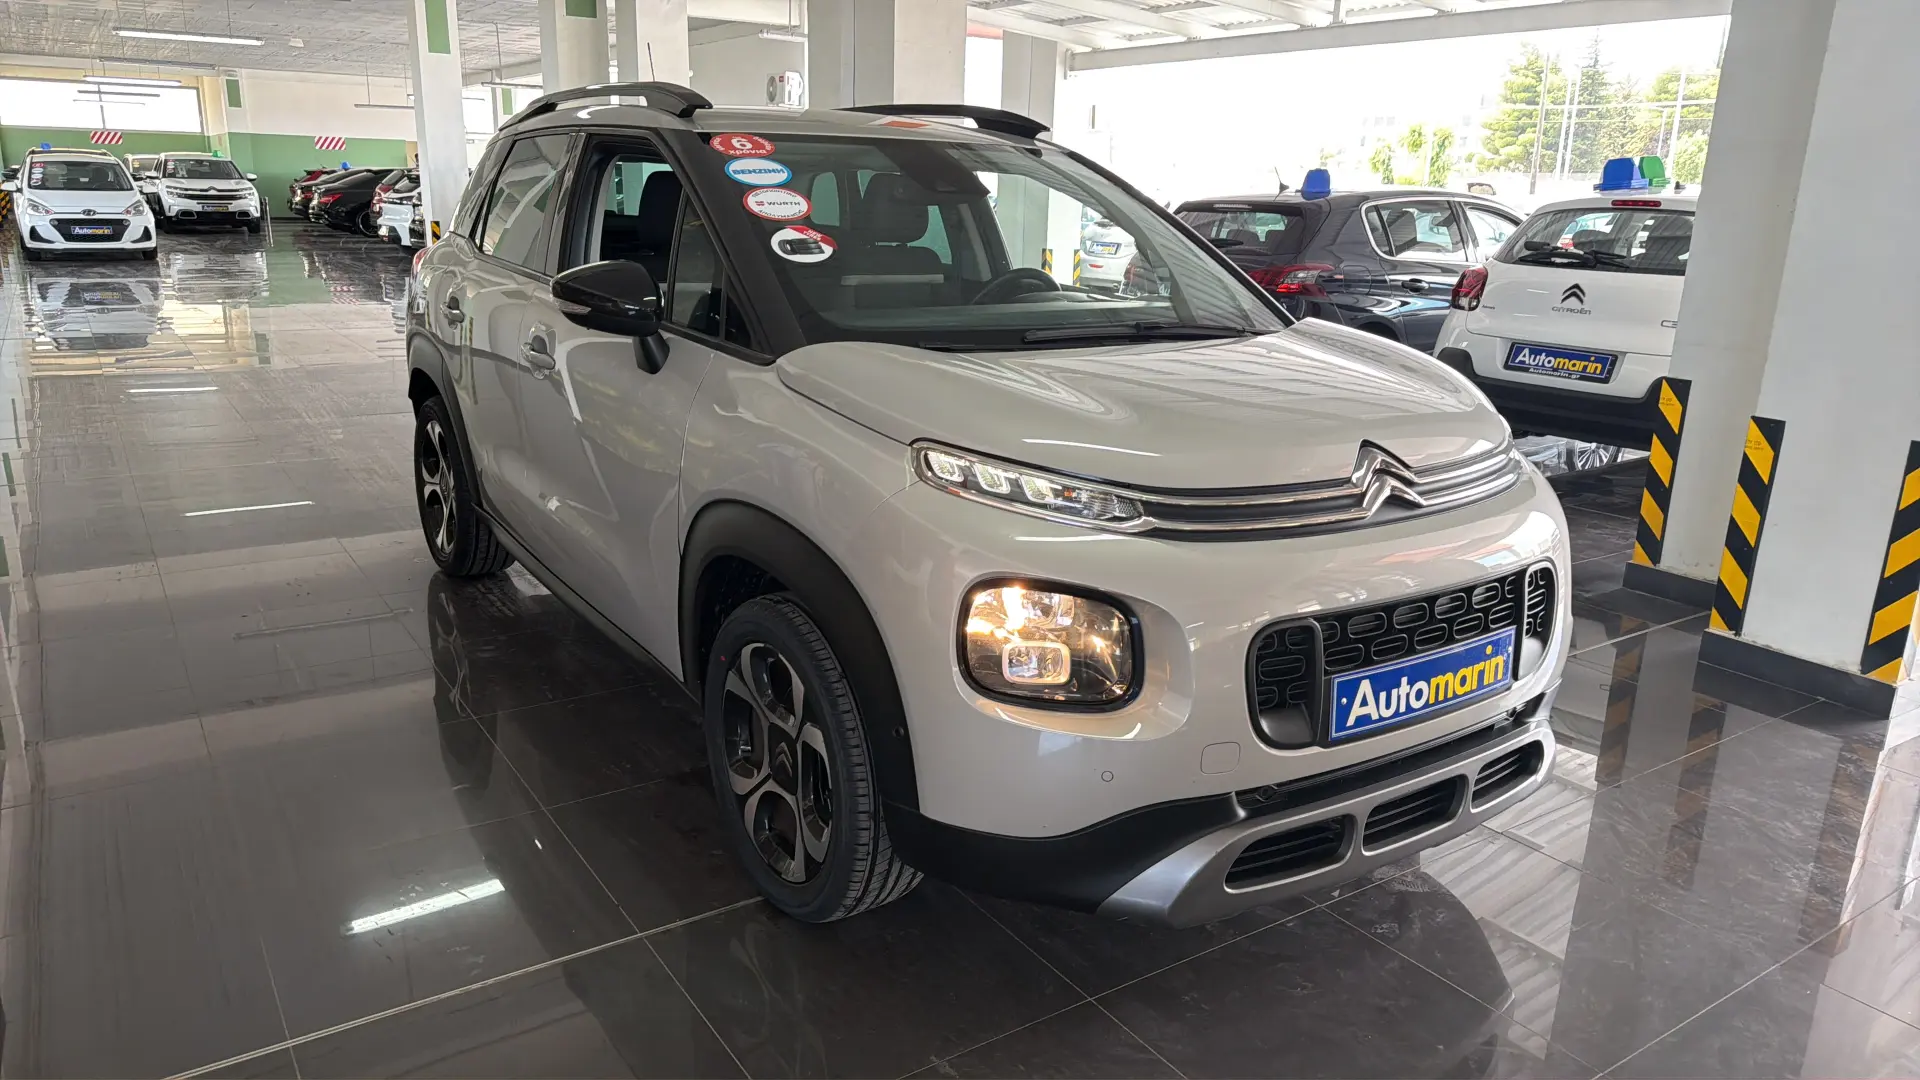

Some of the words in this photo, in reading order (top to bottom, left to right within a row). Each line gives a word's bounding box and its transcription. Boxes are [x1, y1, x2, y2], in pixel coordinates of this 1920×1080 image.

[731, 138, 753, 150] 6
[74, 226, 111, 234] Automarin
[1514, 347, 1603, 375] Automarin
[1528, 367, 1581, 379] Automarin.gr
[1345, 644, 1505, 727] Automarin
